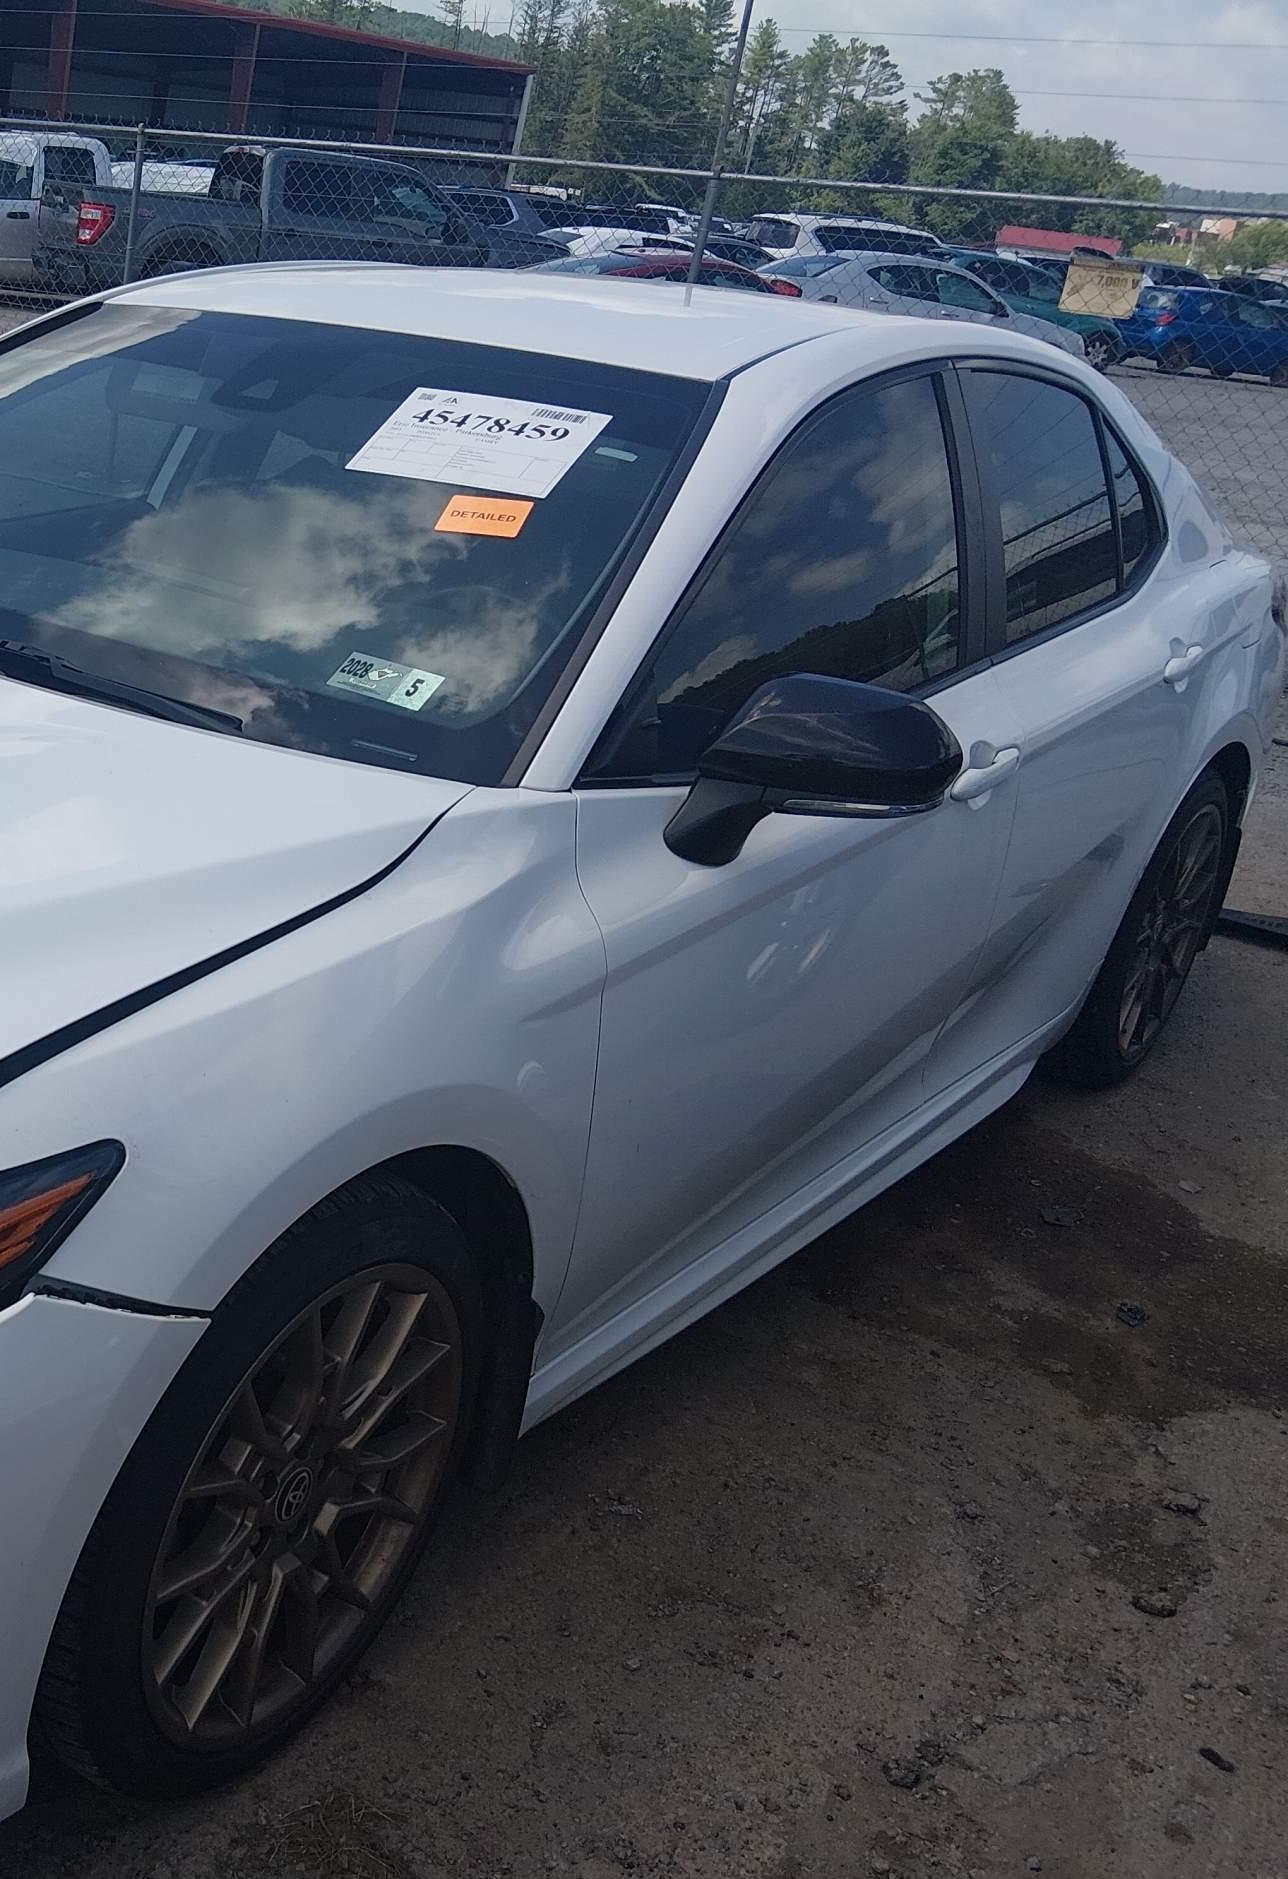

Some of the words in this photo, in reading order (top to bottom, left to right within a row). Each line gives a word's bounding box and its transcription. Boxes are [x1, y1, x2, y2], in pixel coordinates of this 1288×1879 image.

[412, 408, 571, 442] 45478459
[450, 510, 517, 522] DETAILED
[339, 657, 374, 679] 2028
[405, 678, 425, 697] 5
